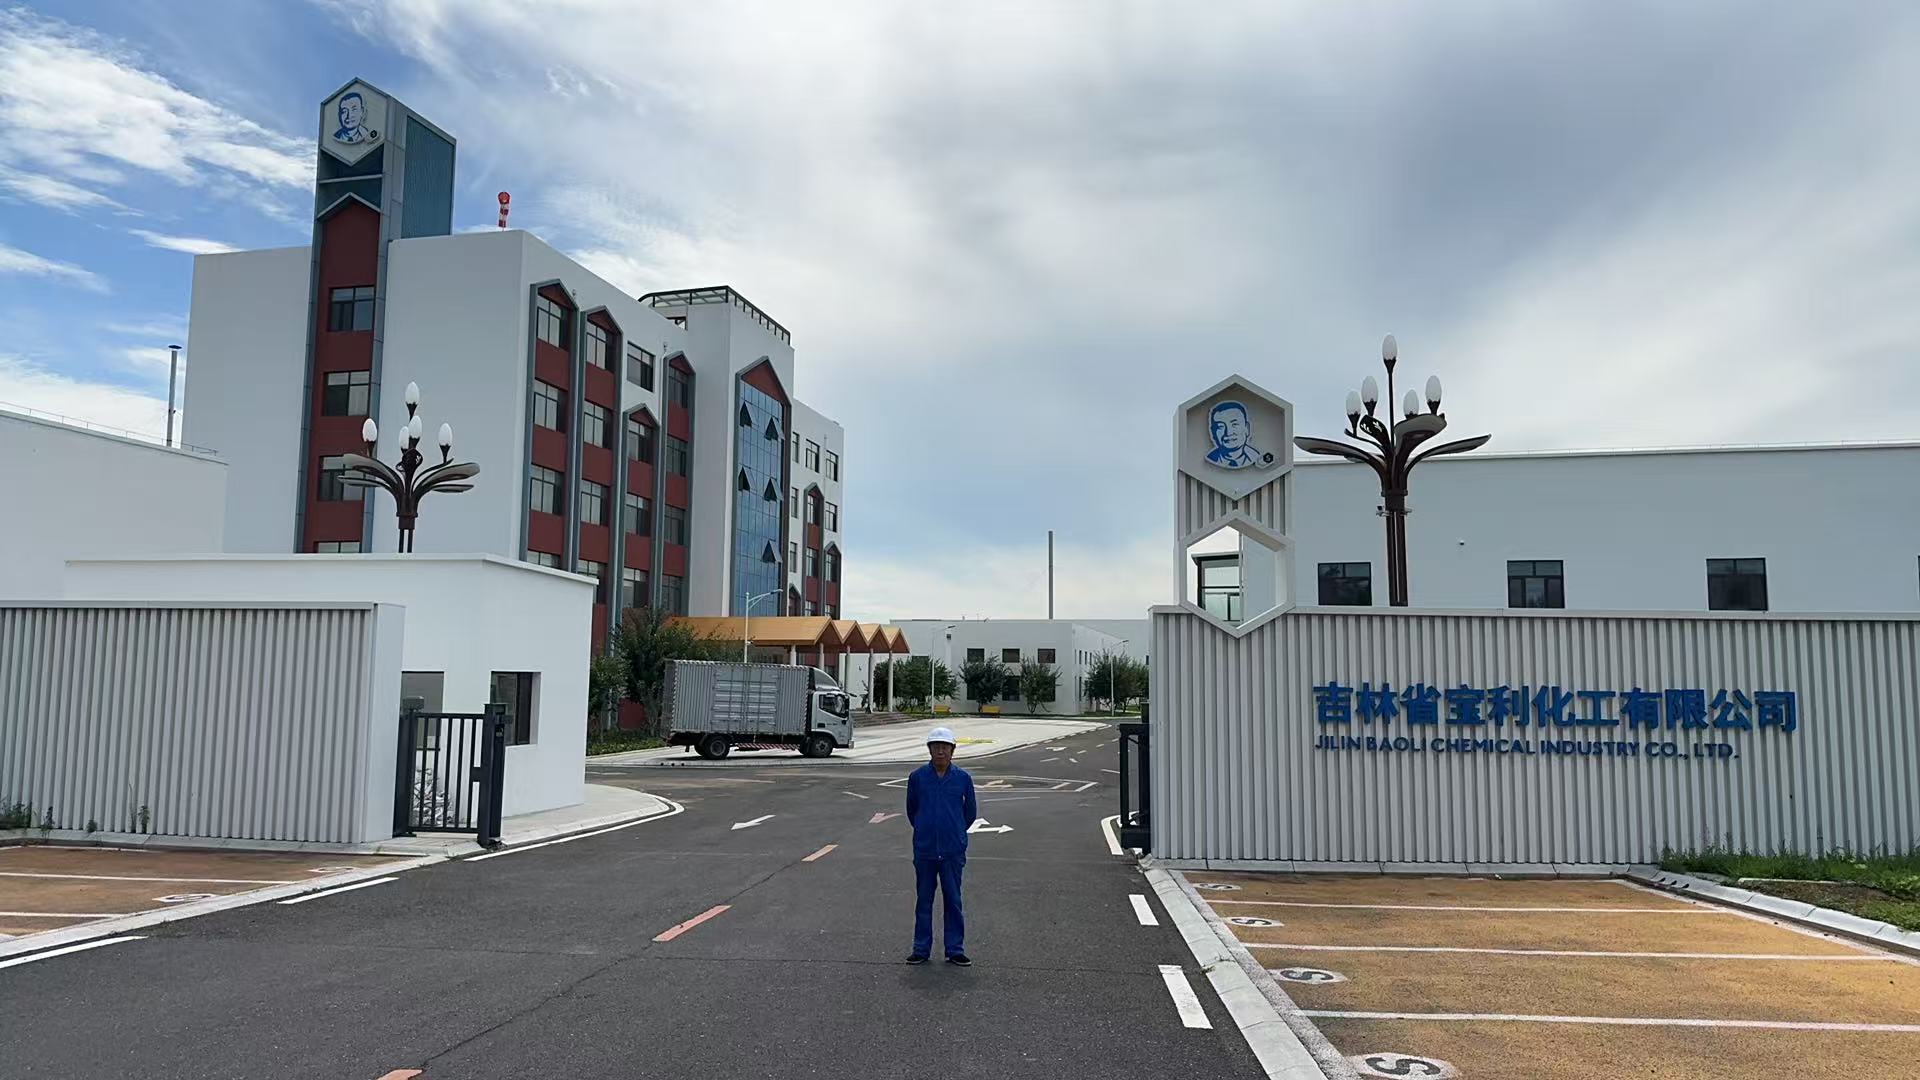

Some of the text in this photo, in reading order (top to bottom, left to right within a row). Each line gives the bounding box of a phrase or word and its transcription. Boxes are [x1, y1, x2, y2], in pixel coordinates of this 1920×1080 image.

[1313, 681, 1796, 733] 吉林省宝利化工有限公司
[1315, 735, 1739, 759] JILIN BAOLI CHEMICAL INDUSTRY CO., LTD.
